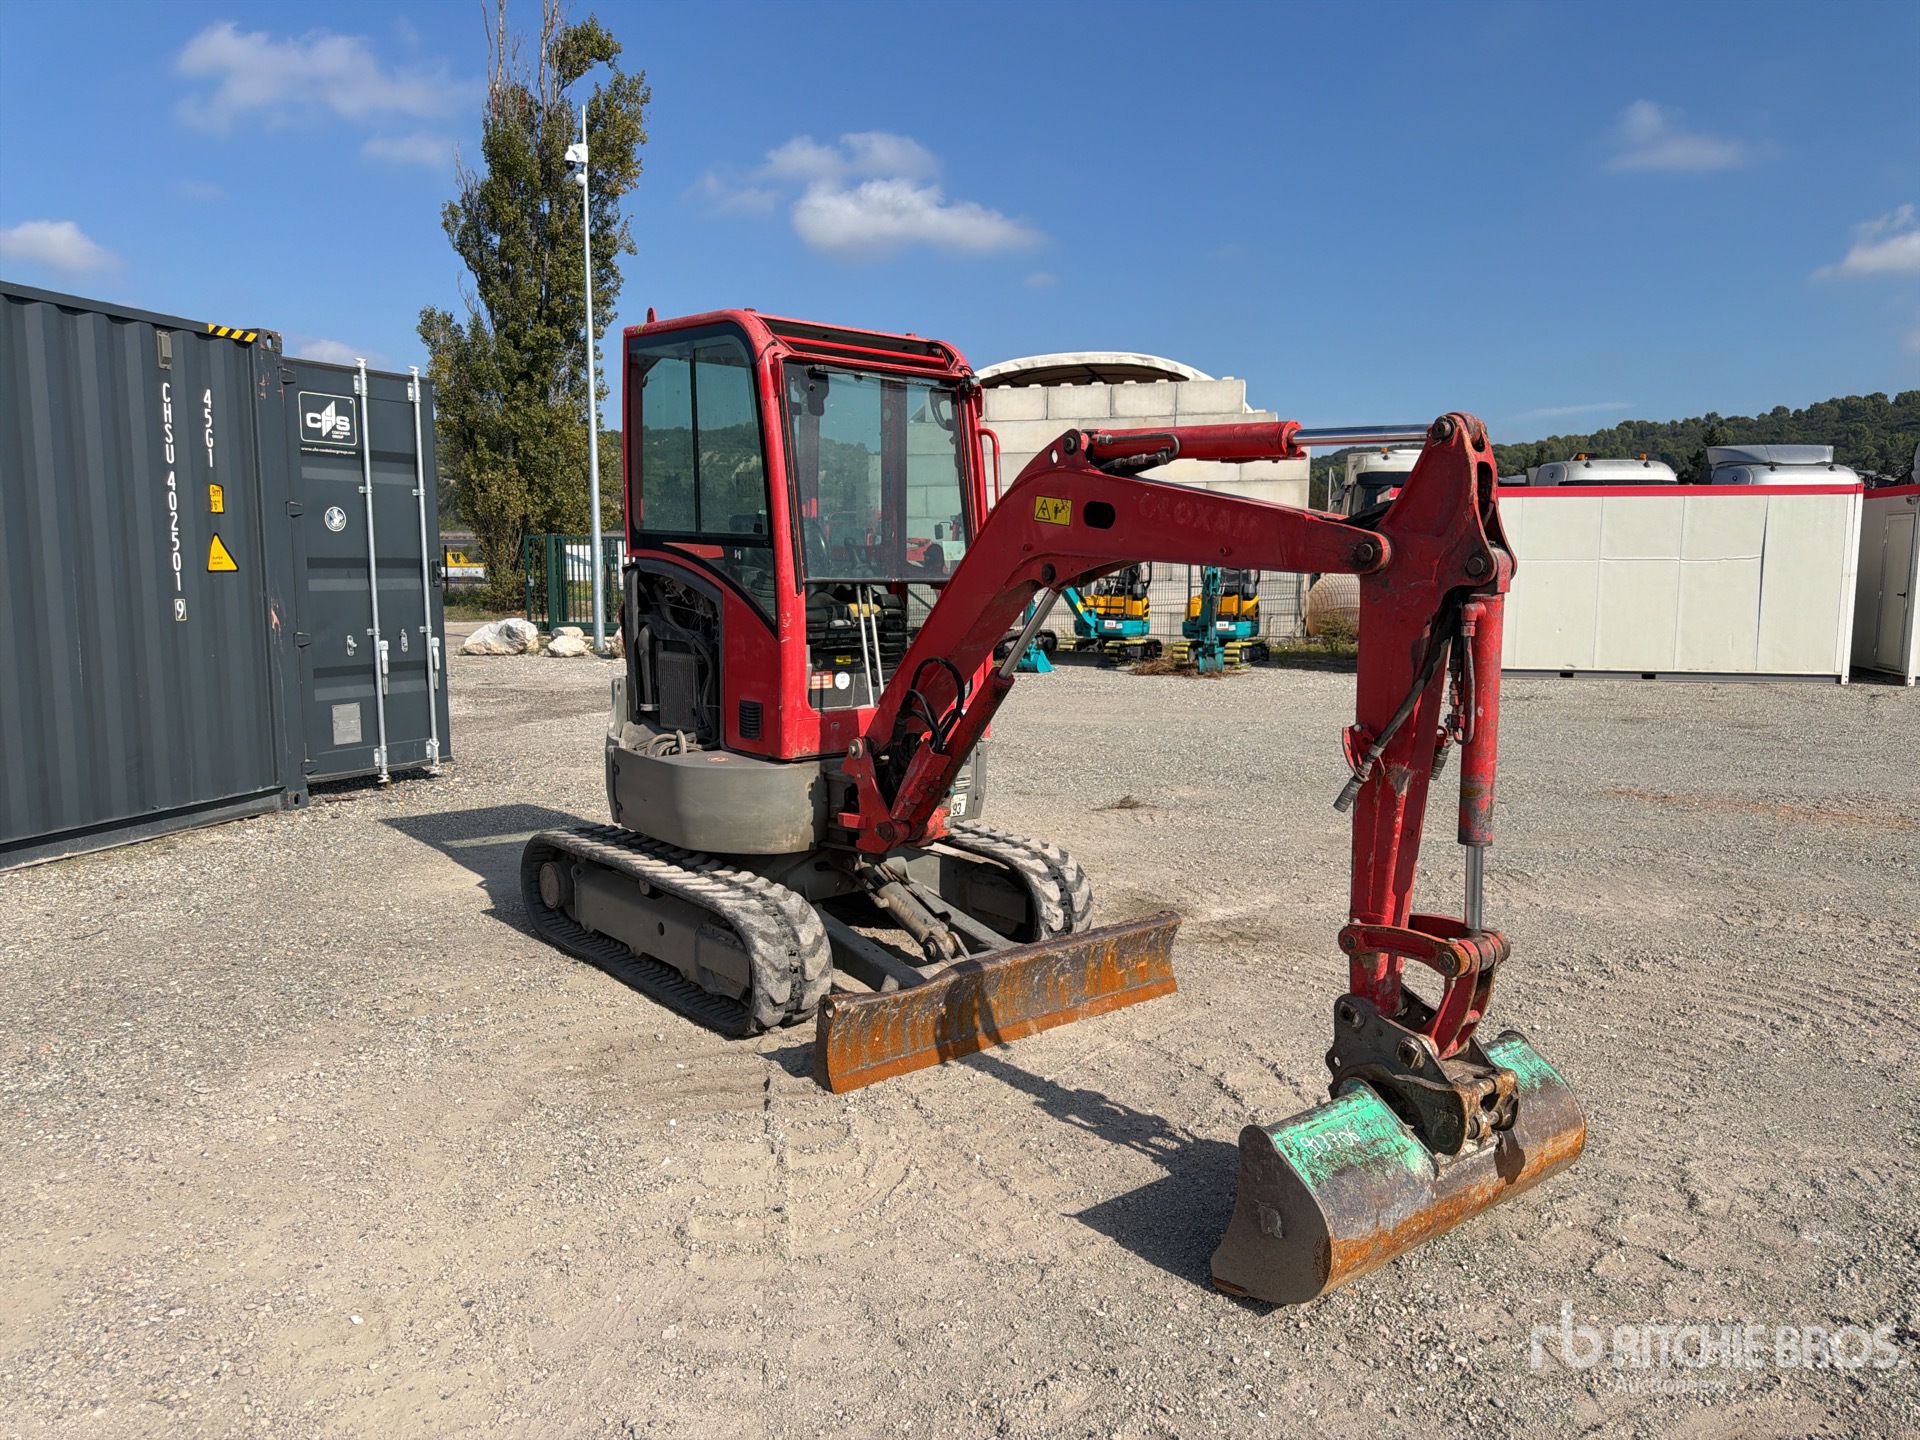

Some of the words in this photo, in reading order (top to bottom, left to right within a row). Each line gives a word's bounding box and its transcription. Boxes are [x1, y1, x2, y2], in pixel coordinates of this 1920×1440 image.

[162, 382, 175, 464] CHSU
[203, 388, 214, 468] 45G1
[306, 400, 351, 437] CHS
[167, 471, 181, 591] 402501
[175, 600, 185, 620] 9
